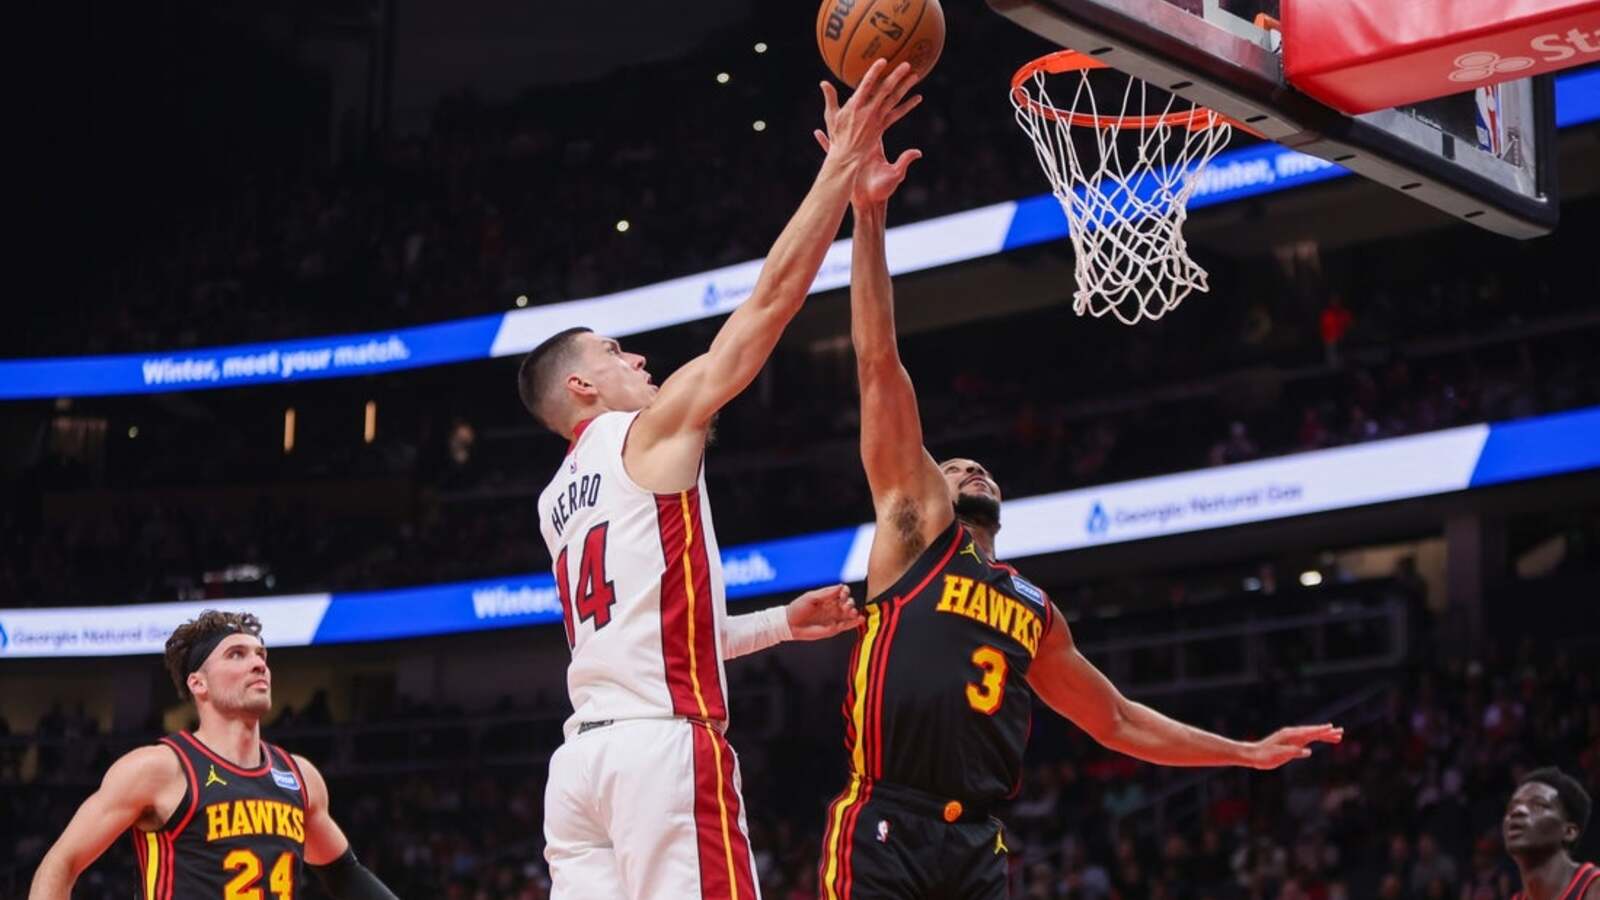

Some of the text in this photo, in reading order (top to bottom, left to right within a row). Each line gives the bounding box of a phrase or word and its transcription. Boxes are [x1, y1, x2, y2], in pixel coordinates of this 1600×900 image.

[142, 334, 411, 385] Winter, meet your match.
[551, 473, 601, 537] HERRO
[1115, 484, 1304, 527] Georgia Natural Gas
[556, 519, 617, 651] 14
[935, 573, 1043, 660] HAWKS
[965, 644, 1009, 716] 3
[205, 799, 305, 844] HAWKS
[223, 849, 296, 900] 24
